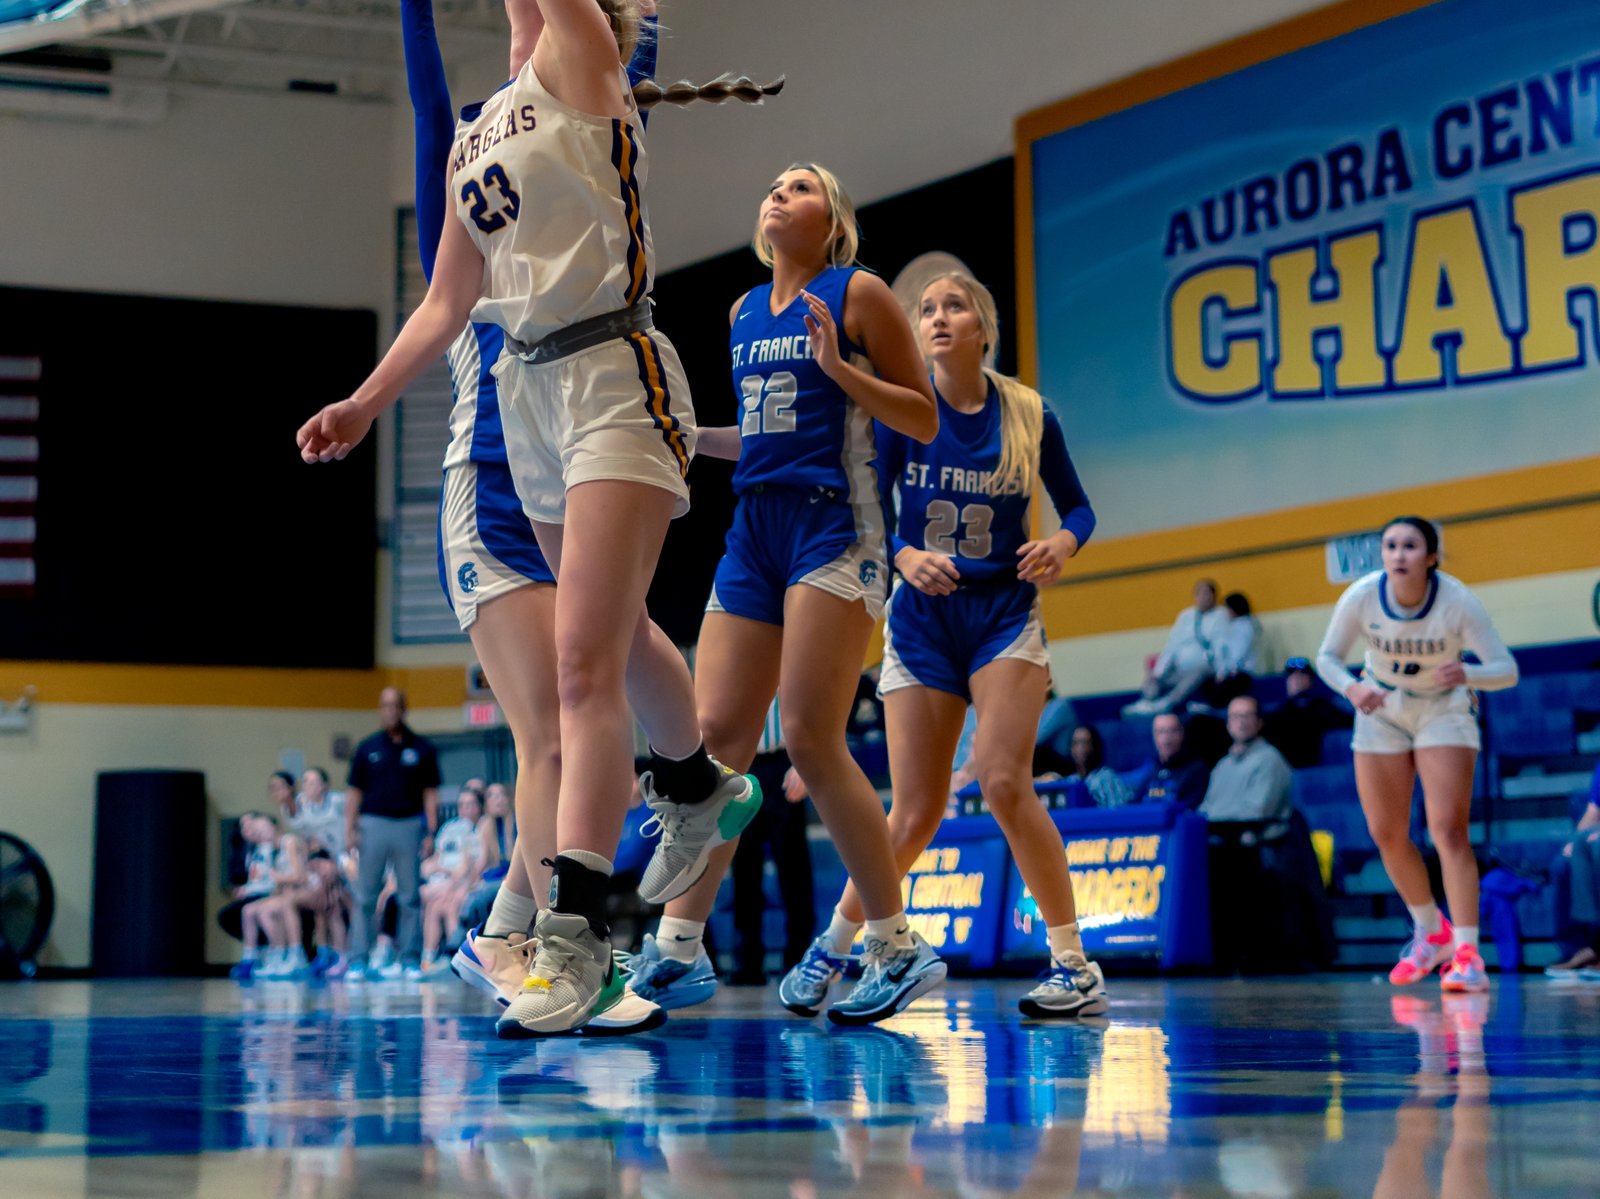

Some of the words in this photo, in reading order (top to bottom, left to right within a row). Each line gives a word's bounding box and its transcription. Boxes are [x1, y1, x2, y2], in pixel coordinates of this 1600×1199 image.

[460, 160, 522, 236] 23
[1163, 127, 1413, 258] AURORA
[748, 335, 816, 365] FRANCI
[740, 371, 797, 437] 22
[905, 460, 935, 489] ST.
[924, 499, 995, 559] 23
